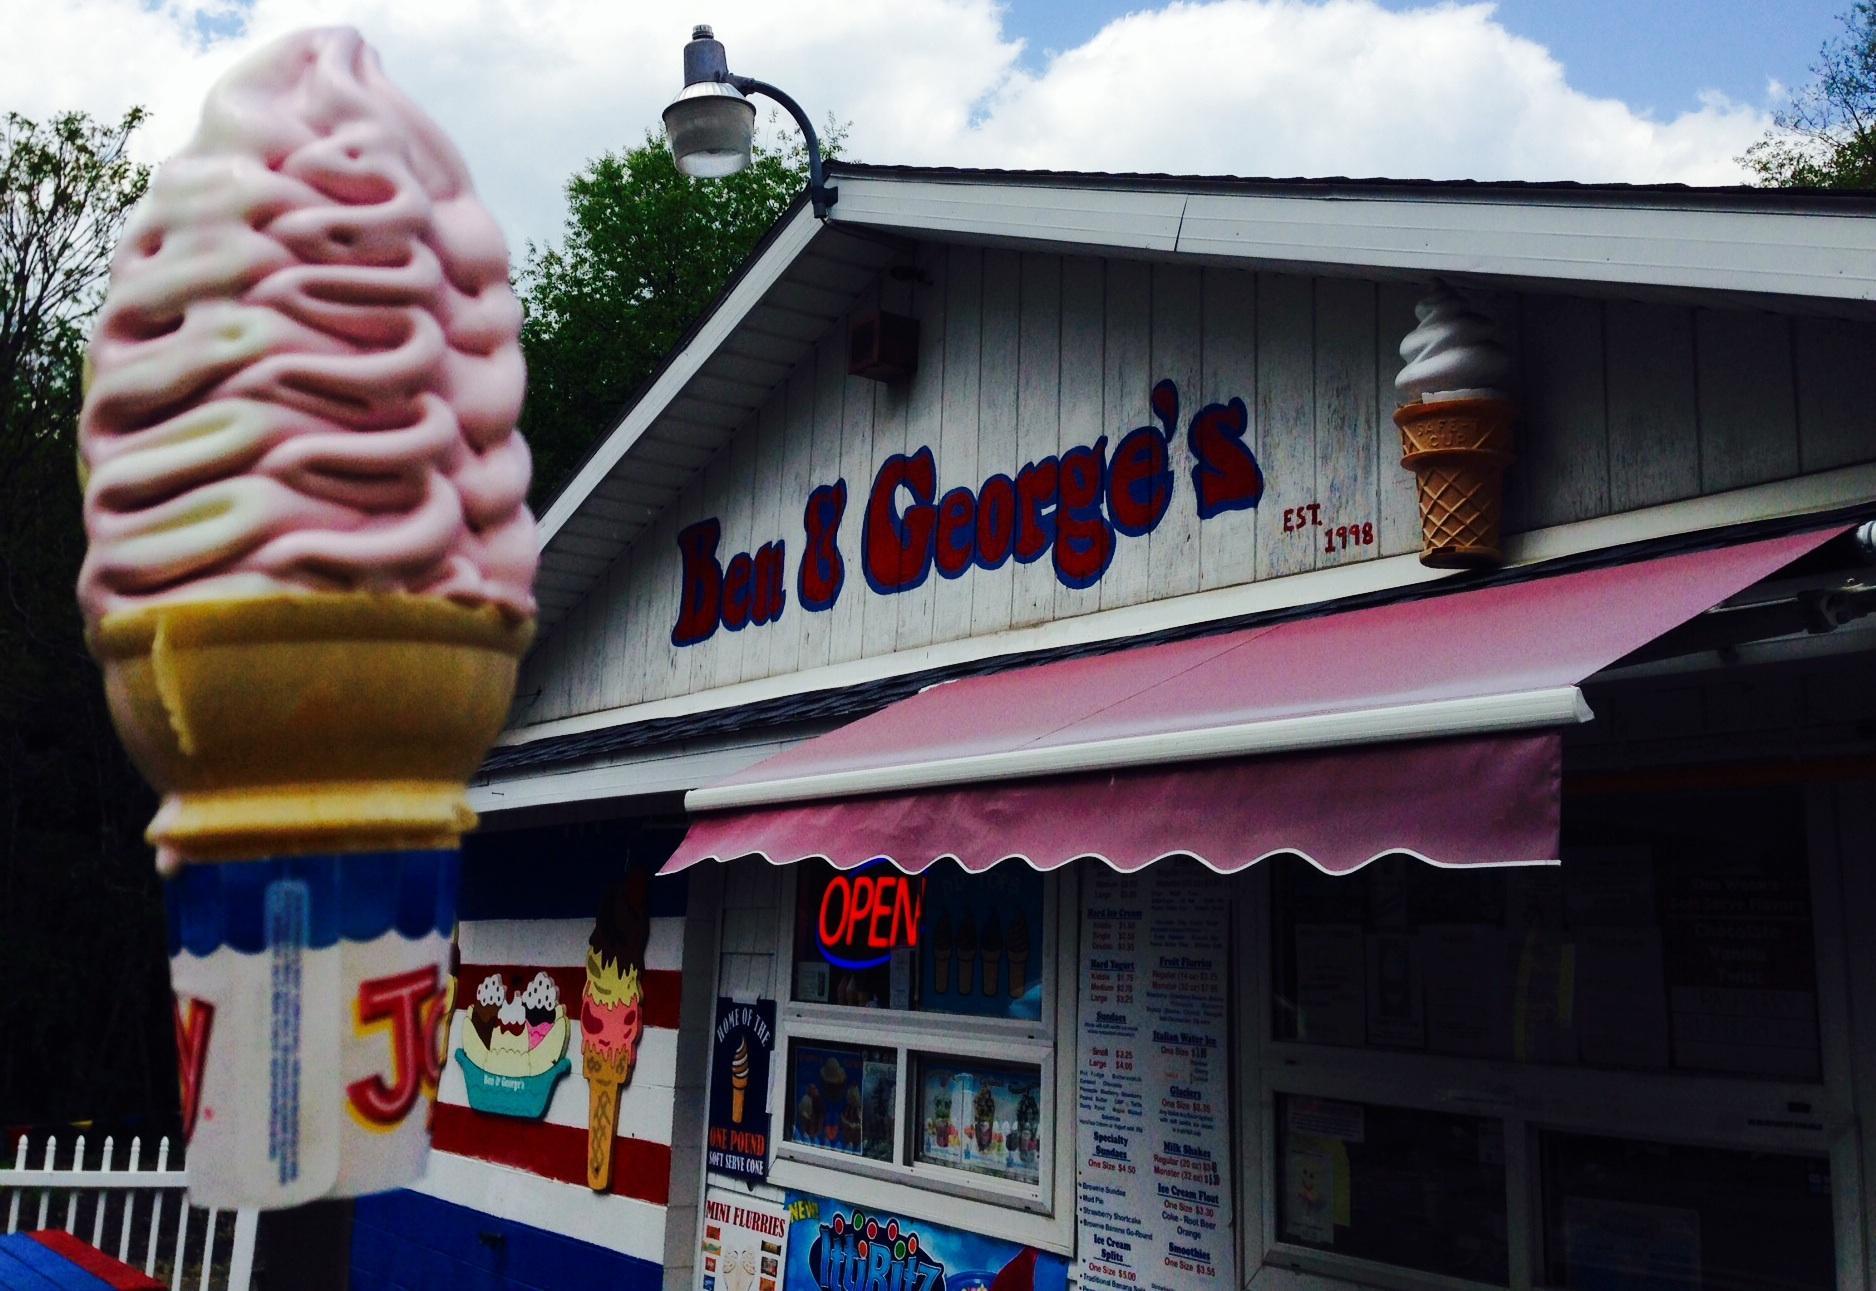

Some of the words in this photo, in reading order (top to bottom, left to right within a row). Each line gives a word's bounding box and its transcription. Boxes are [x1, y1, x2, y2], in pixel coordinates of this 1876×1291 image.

[671, 516, 786, 648] Ben
[861, 378, 1264, 595] George's
[1283, 503, 1323, 533] EST.
[1325, 521, 1374, 554] 1998
[817, 874, 928, 949] OPEN
[717, 1008, 740, 1043] HOME
[742, 1007, 753, 1027] OF
[754, 1013, 771, 1048] THE
[1089, 1059, 1107, 1069] Large
[710, 1126, 729, 1150] ONE
[730, 1130, 765, 1157] POUND
[1094, 1131, 1128, 1147] Specialty
[1096, 1145, 1127, 1159] Sundaes
[1164, 1140, 1181, 1153] Milk
[1183, 1144, 1211, 1158] Shakes
[709, 1151, 723, 1167] SOFT
[725, 1154, 745, 1172] SERVE
[746, 1158, 764, 1175] CONE
[1088, 1159, 1101, 1168] One
[1102, 1161, 1115, 1170] Size
[1118, 1164, 1136, 1174] $4.50
[1153, 1154, 1179, 1165] Regular
[1154, 1166, 1180, 1177] Monster
[1158, 1182, 1169, 1194] Ice
[1171, 1185, 1197, 1199] Cream
[1198, 1190, 1219, 1204] Float
[789, 1201, 819, 1222] NEW!
[1083, 1206, 1112, 1220] Strawberry
[1113, 1212, 1141, 1224] Shortcake
[1164, 1199, 1178, 1210] One
[1179, 1202, 1193, 1213] Size
[706, 1200, 731, 1223] MINI
[733, 1206, 785, 1238] FLURRIES
[1162, 1210, 1178, 1222] Coke
[1183, 1215, 1199, 1227] Root
[1200, 1218, 1216, 1230] Beer
[1177, 1226, 1201, 1240] Orange
[1094, 1234, 1104, 1245] Ice
[1106, 1237, 1131, 1251] Cream
[1169, 1242, 1210, 1260] Smoothies
[1101, 1248, 1123, 1263] Splits
[1164, 1257, 1178, 1268] One
[1179, 1260, 1193, 1271] Size
[1084, 1273, 1111, 1286] Traditional
[1089, 1262, 1101, 1272] One
[1103, 1266, 1116, 1276] Size
[1119, 1269, 1137, 1281] $5.00
